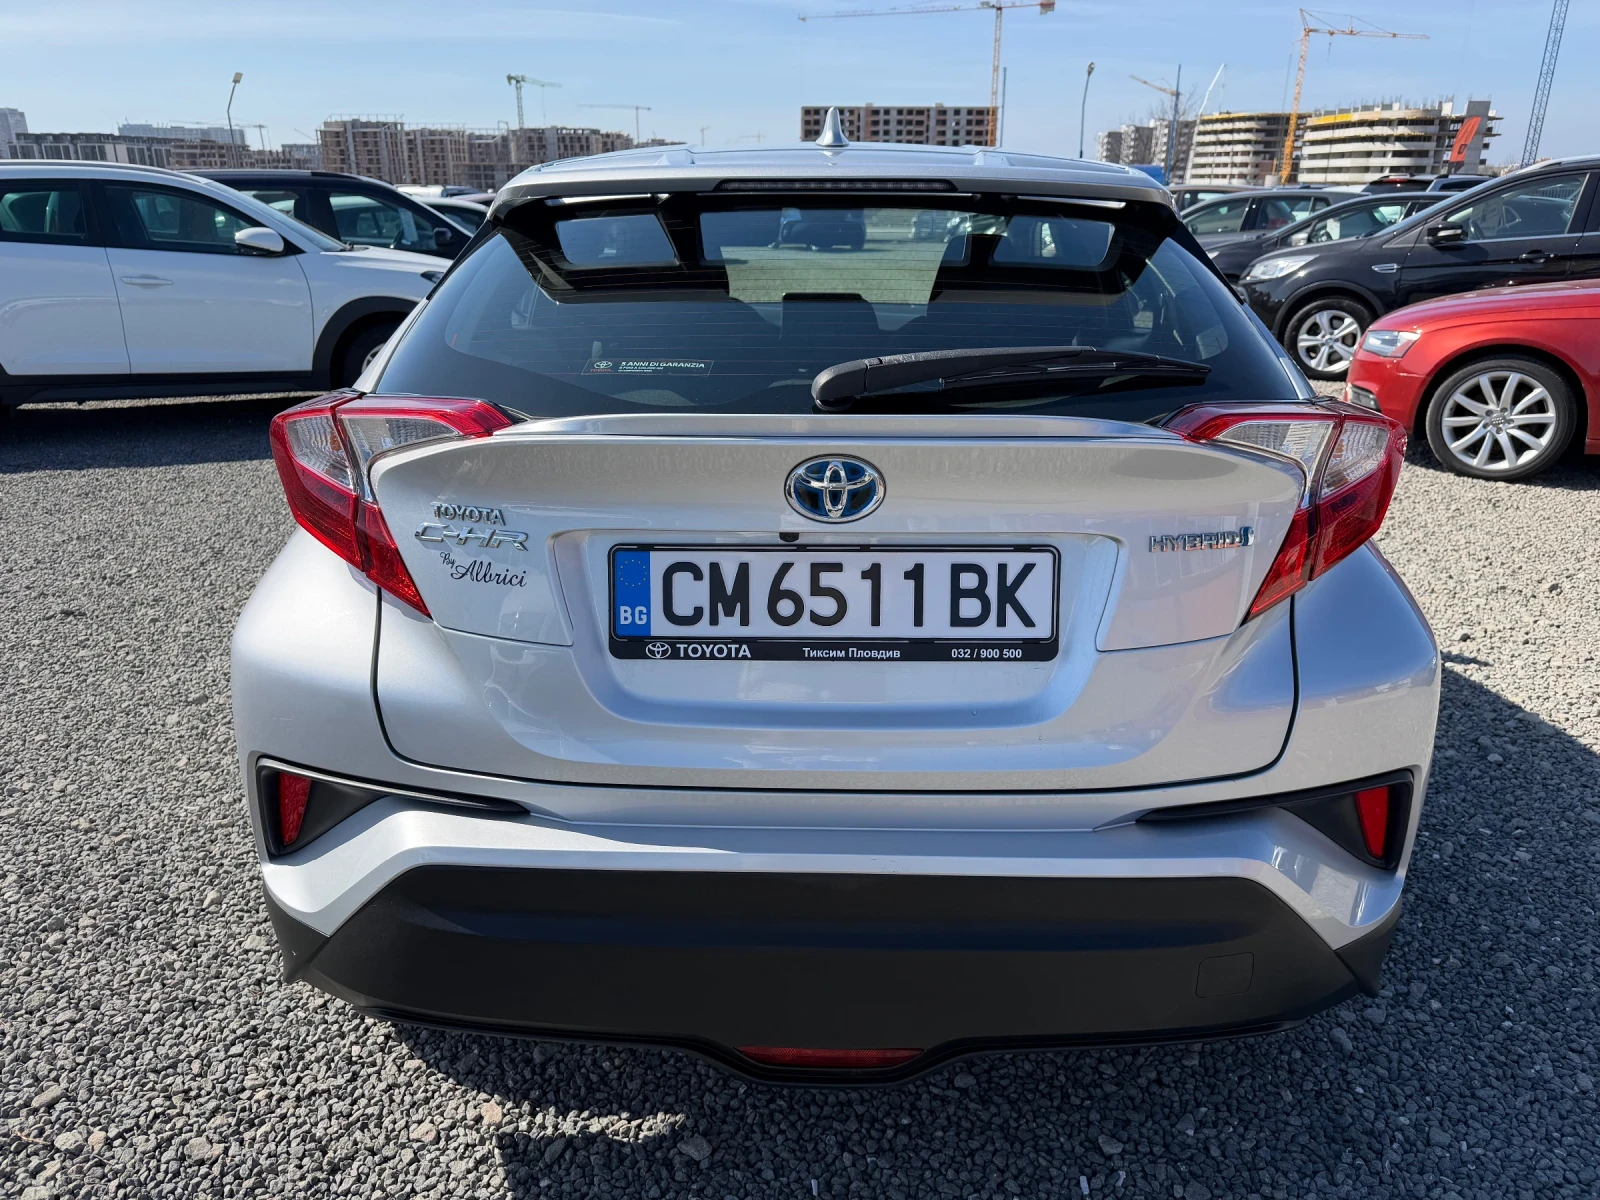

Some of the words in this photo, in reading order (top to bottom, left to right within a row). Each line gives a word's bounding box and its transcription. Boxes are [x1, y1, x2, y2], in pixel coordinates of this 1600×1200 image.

[431, 502, 506, 526] TOYOTA
[414, 521, 529, 551] C-HR
[1148, 531, 1240, 553] HYBRID
[440, 551, 456, 569] By
[450, 559, 527, 588] Albrici
[662, 561, 750, 627] CM
[767, 562, 925, 627] 6511
[950, 562, 1037, 628] BK
[619, 605, 648, 625] BG
[676, 643, 752, 659] TOYOTA
[802, 647, 846, 659] Тиксим
[848, 647, 901, 660] Пловдив
[951, 648, 971, 659] 032
[980, 648, 1000, 659] 900
[1002, 648, 1022, 659] 500
